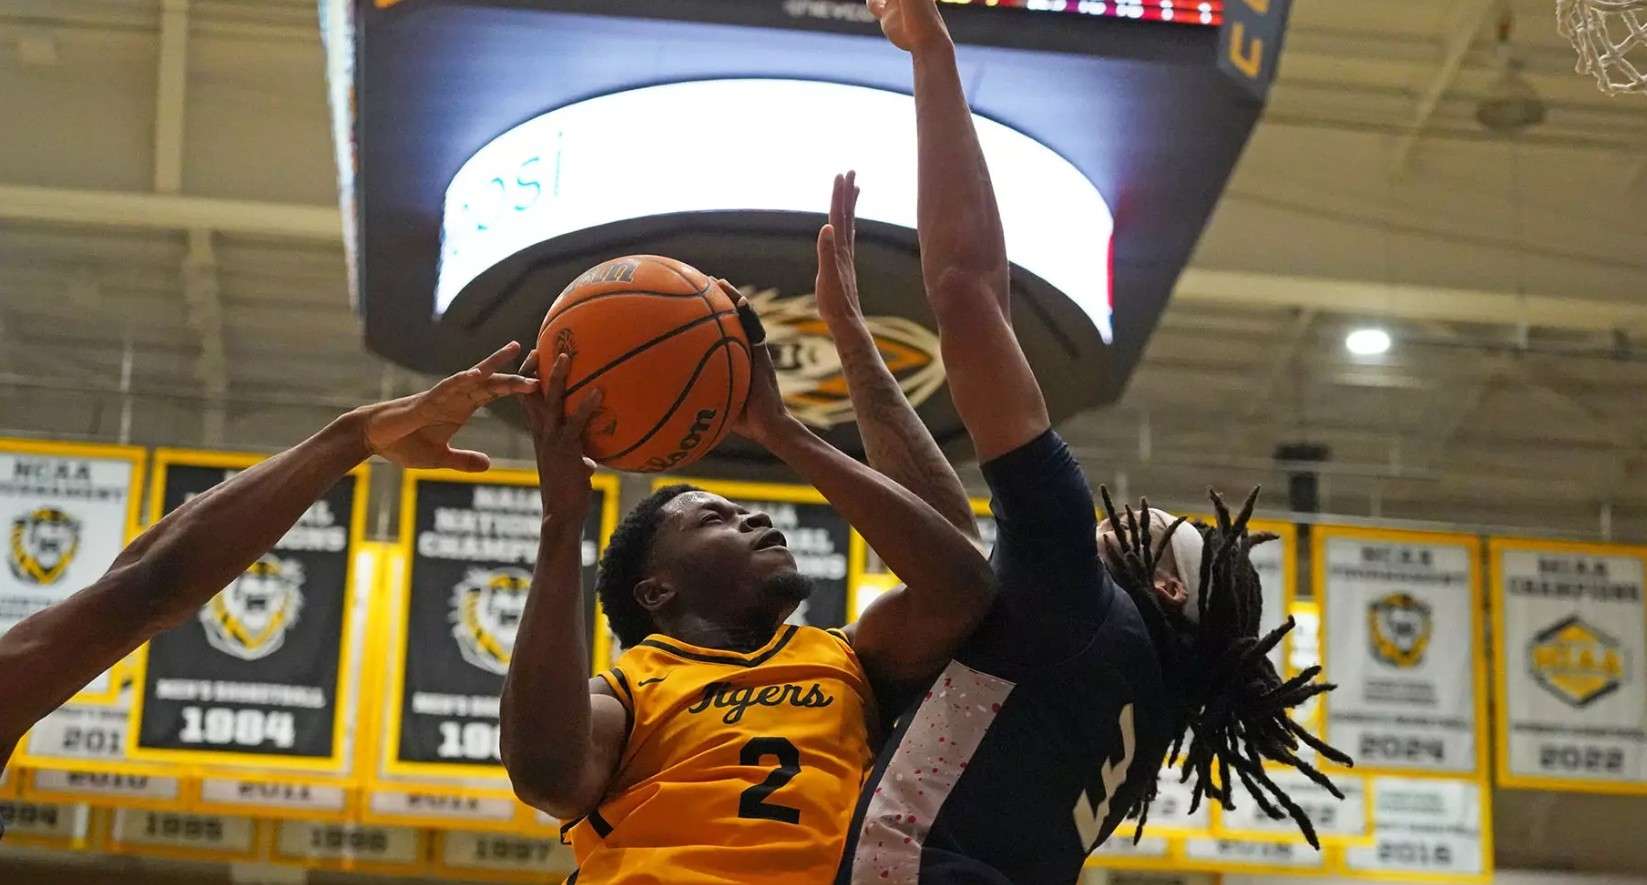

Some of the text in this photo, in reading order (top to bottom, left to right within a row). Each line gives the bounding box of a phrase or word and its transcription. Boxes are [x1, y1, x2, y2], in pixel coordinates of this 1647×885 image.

[688, 682, 833, 724] Tigers
[62, 725, 121, 750] 201
[738, 736, 801, 825] 2
